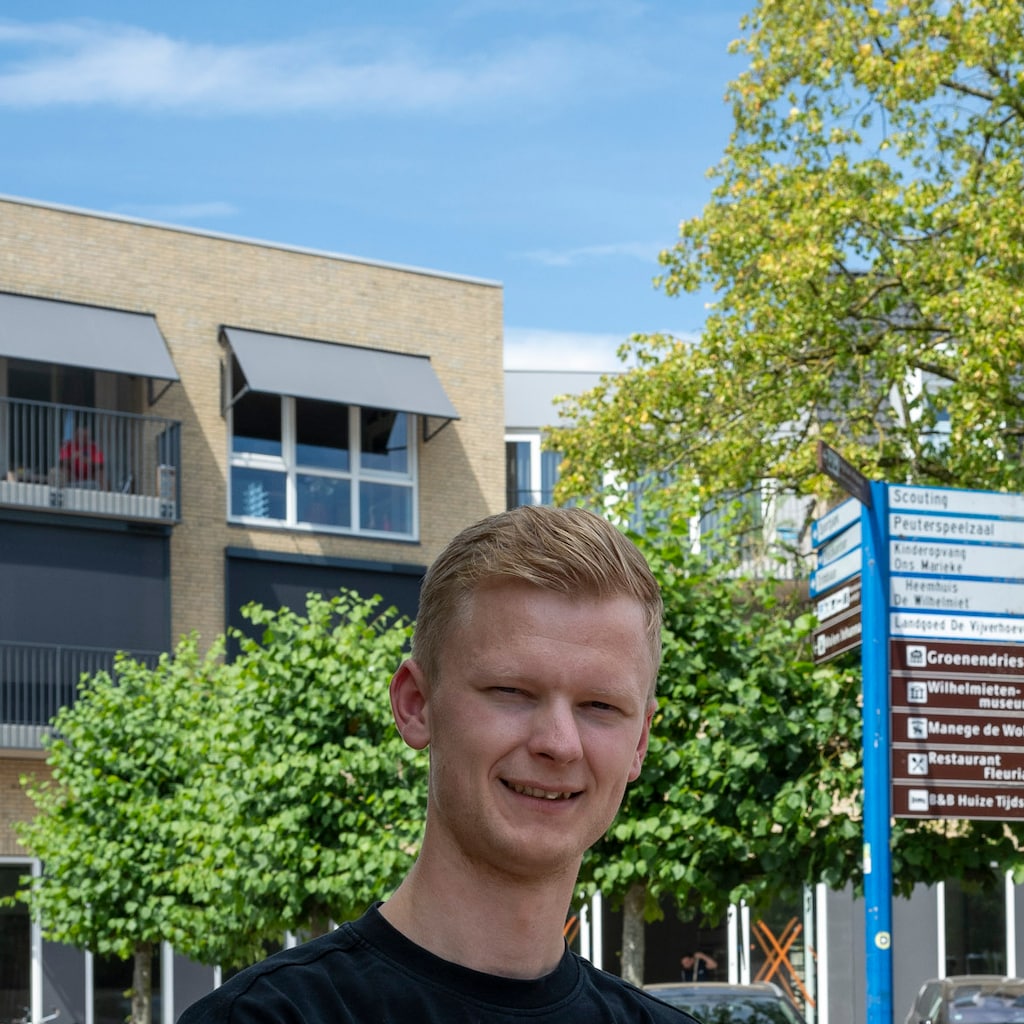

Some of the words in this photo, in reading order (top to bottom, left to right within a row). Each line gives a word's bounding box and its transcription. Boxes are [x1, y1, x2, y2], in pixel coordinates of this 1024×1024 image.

[894, 489, 948, 508] Scouting
[894, 516, 995, 536] Peuterspeelzaal
[894, 543, 966, 561] Kinderopvang
[894, 558, 914, 571] Ons
[921, 559, 963, 573] Marieke
[905, 580, 958, 592] Heemhuis
[894, 594, 907, 606] De
[914, 596, 970, 609] Wilhelmiet
[894, 616, 946, 632] Landgoed
[951, 619, 964, 631] De
[927, 650, 1024, 668] Groenendries
[927, 680, 1021, 698] Wilhelmieten-
[927, 721, 981, 738] Manege
[983, 724, 1000, 736] de
[927, 751, 1002, 766] Restaurant
[928, 793, 955, 807] B&B
[957, 794, 994, 808] Huize
